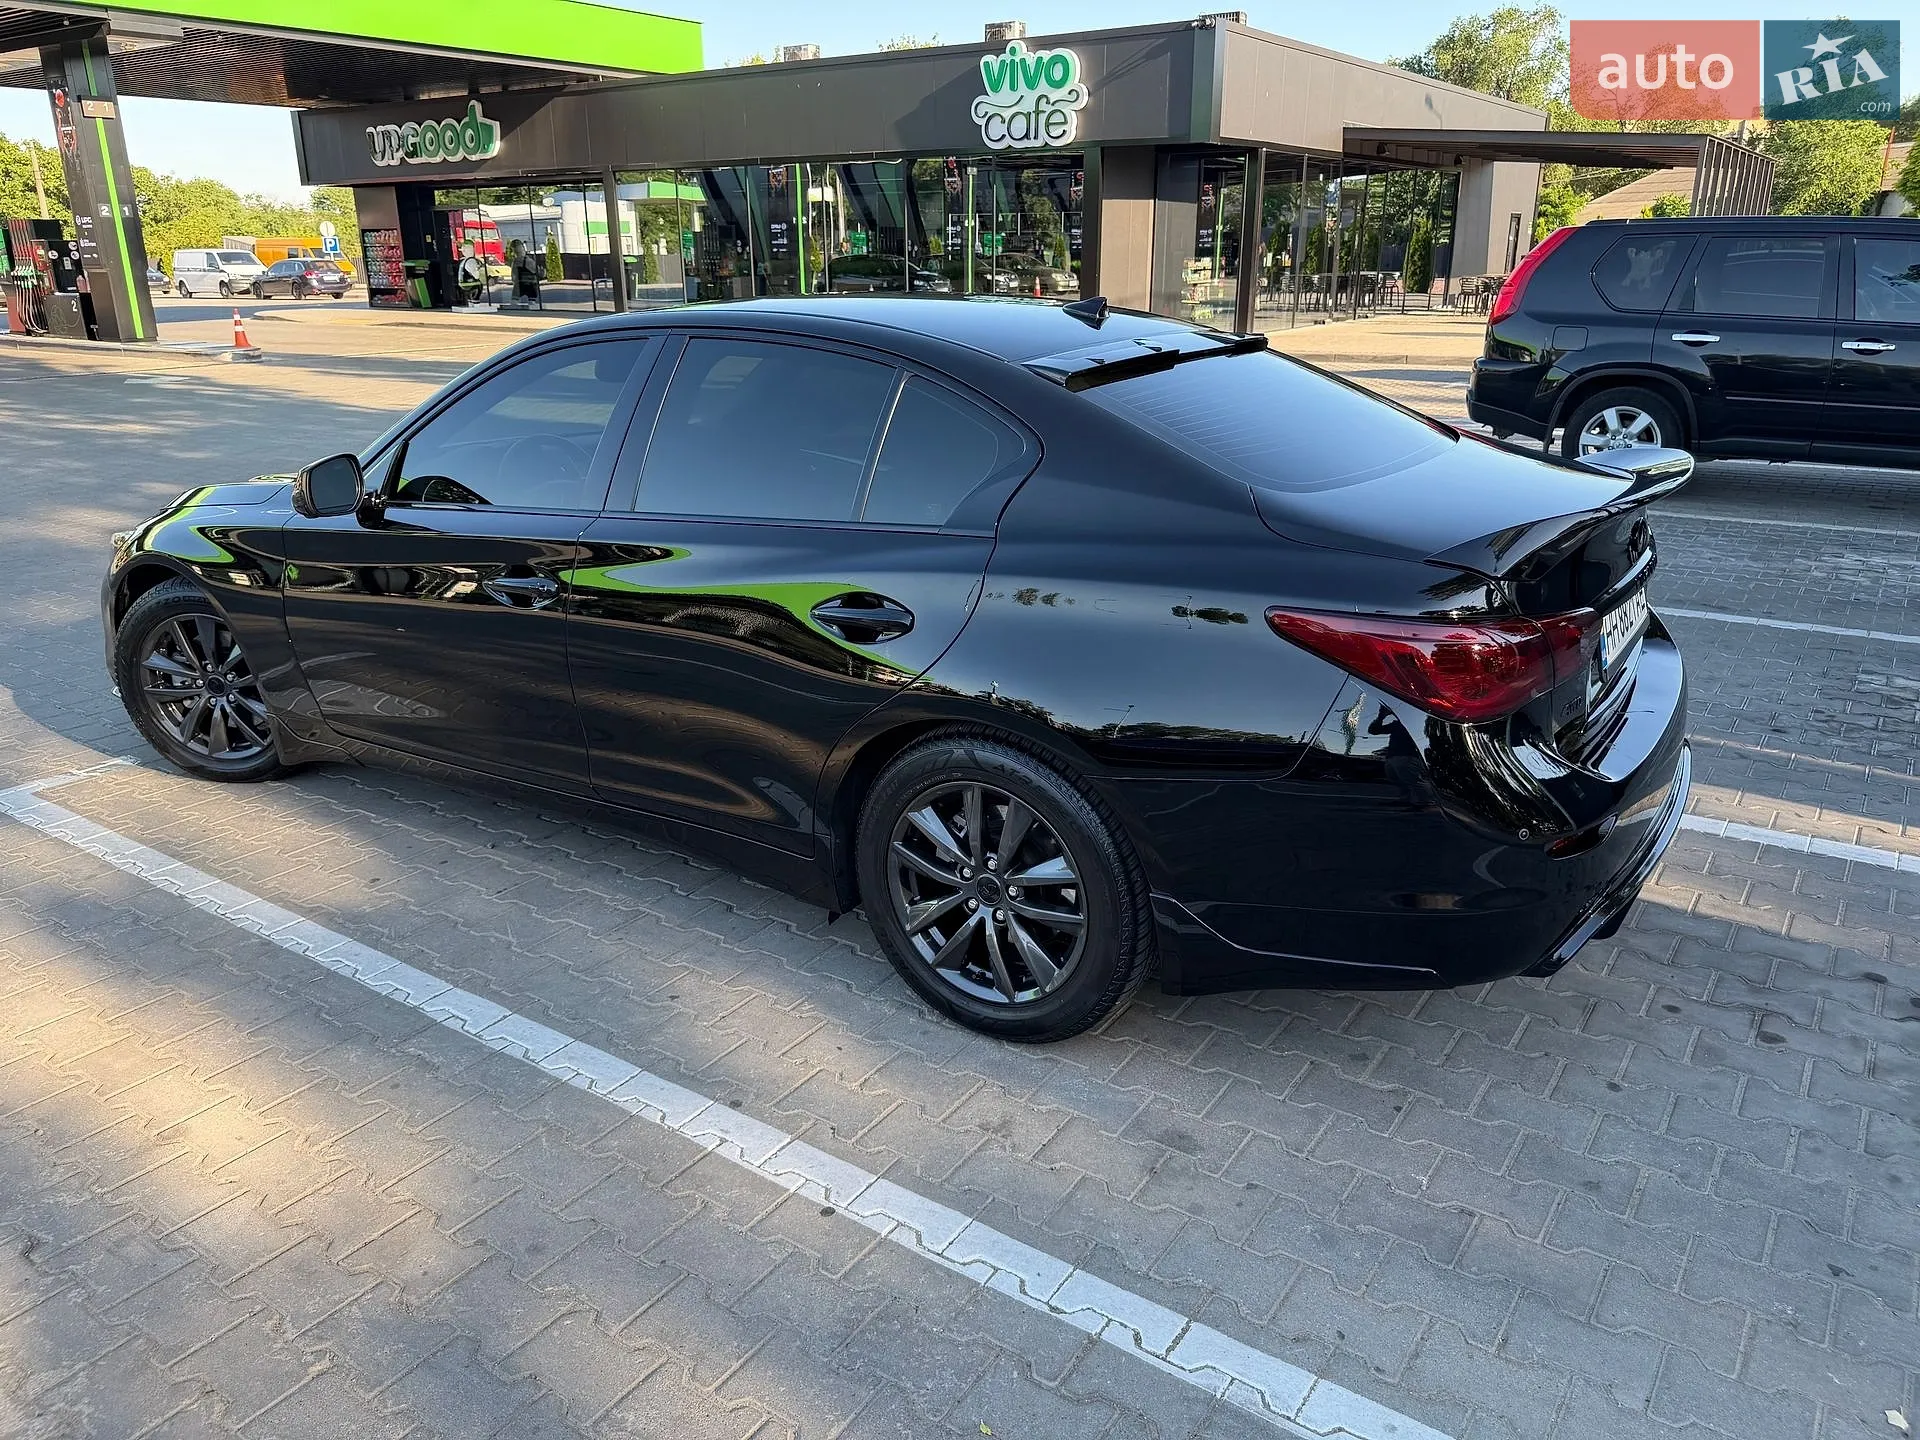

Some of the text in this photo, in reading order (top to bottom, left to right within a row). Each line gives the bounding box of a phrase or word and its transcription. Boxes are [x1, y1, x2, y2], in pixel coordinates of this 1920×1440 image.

[983, 46, 1070, 93] vivo
[86, 101, 94, 111] 2
[100, 206, 129, 216] 2 1
[326, 238, 336, 252] P
[71, 300, 78, 312] 2
